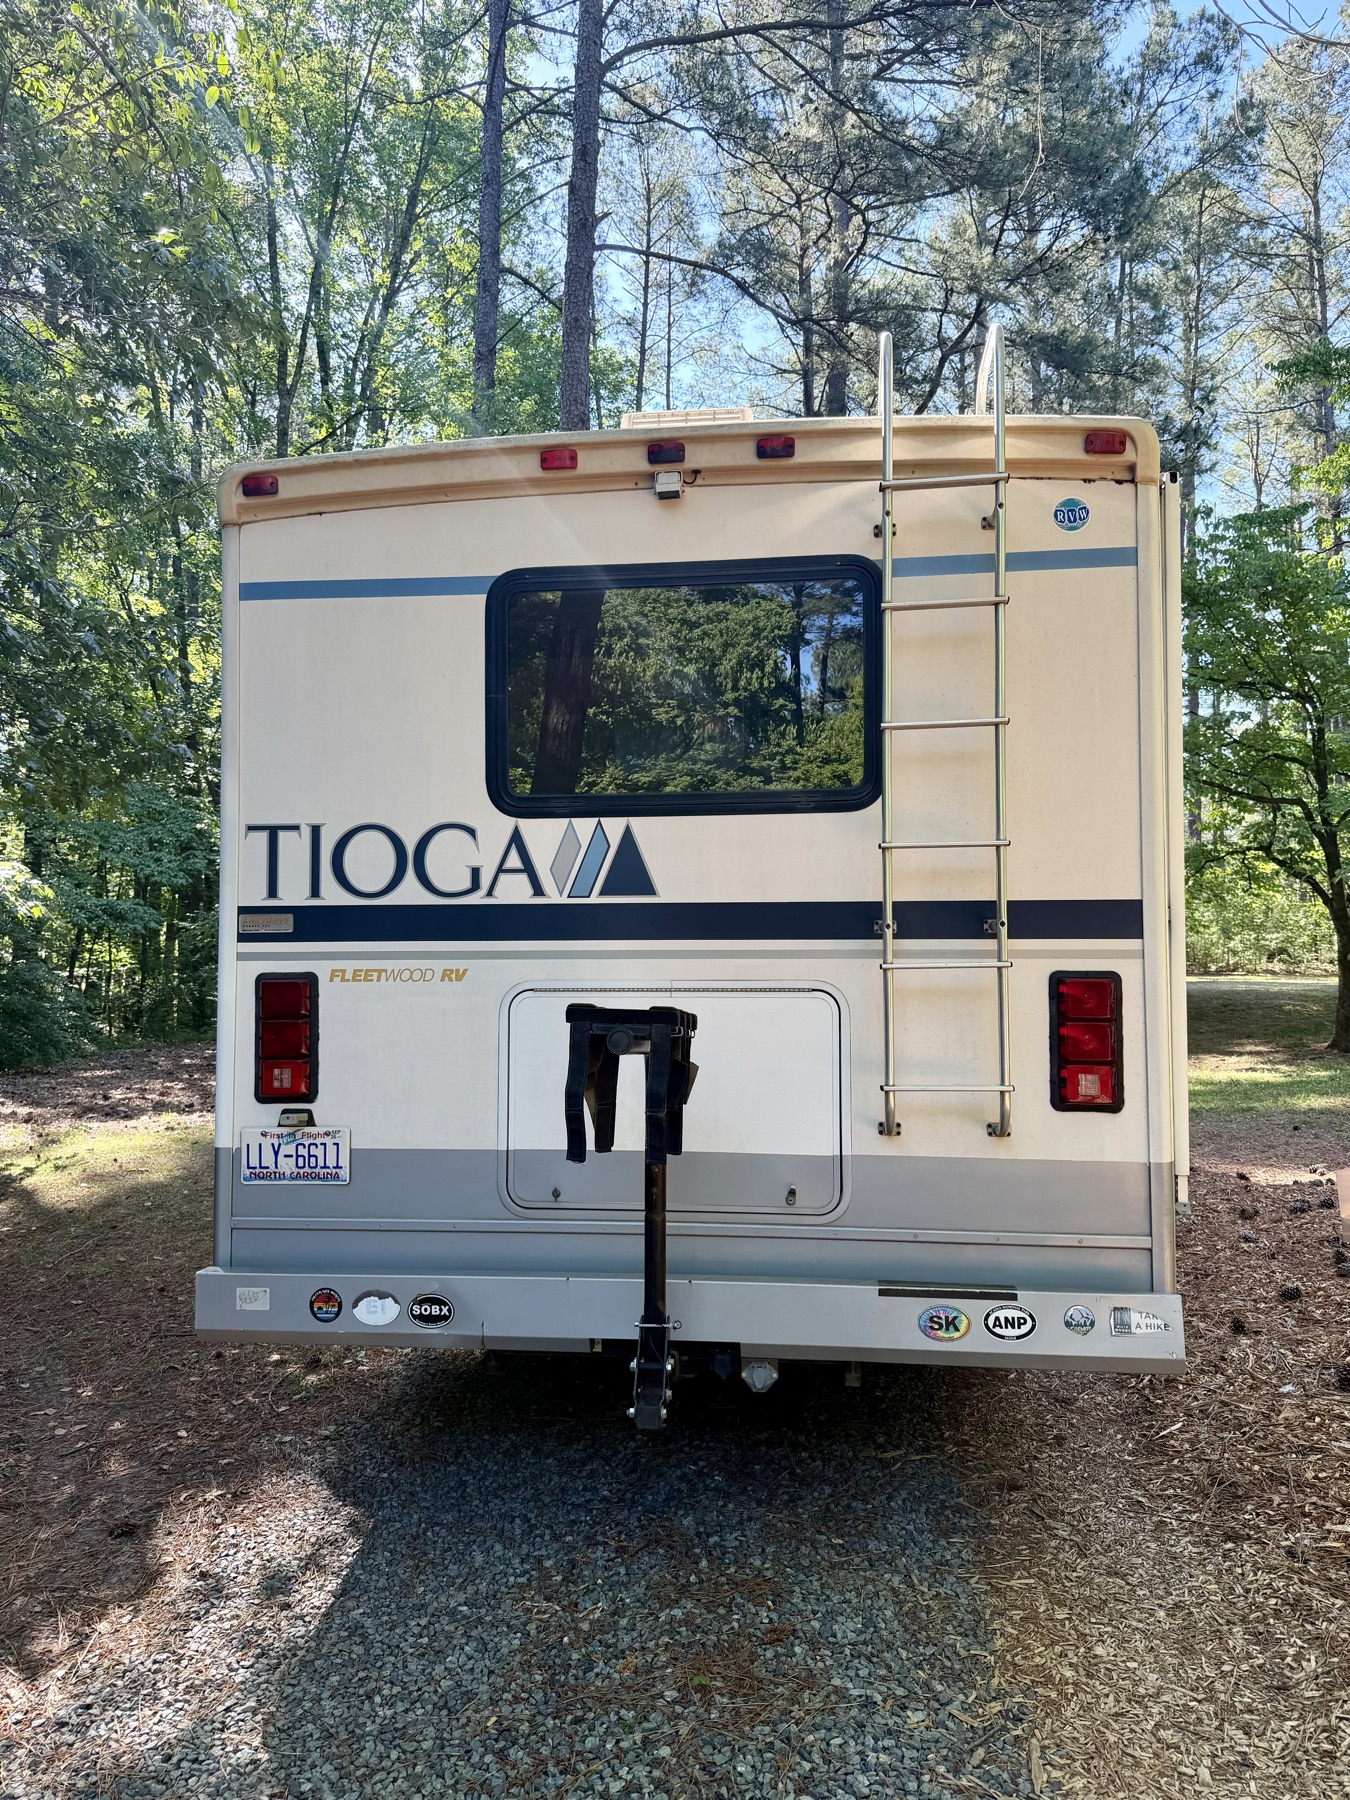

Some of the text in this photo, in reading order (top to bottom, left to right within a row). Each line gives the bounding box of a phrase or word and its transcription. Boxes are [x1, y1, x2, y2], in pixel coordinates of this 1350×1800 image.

[1057, 508, 1088, 522] RVW
[245, 819, 552, 901] TIOGA
[329, 968, 468, 982] FLEETWOOD RV
[264, 1131, 284, 1139] First
[301, 1131, 326, 1140] Flight
[246, 1142, 343, 1170] LLY-6611
[249, 1171, 340, 1180] NORTH CAROLINA
[412, 1304, 450, 1316] SOBX
[928, 1315, 961, 1332] SK
[992, 1316, 1028, 1330] ANP
[1135, 1322, 1170, 1331] A HIKE
